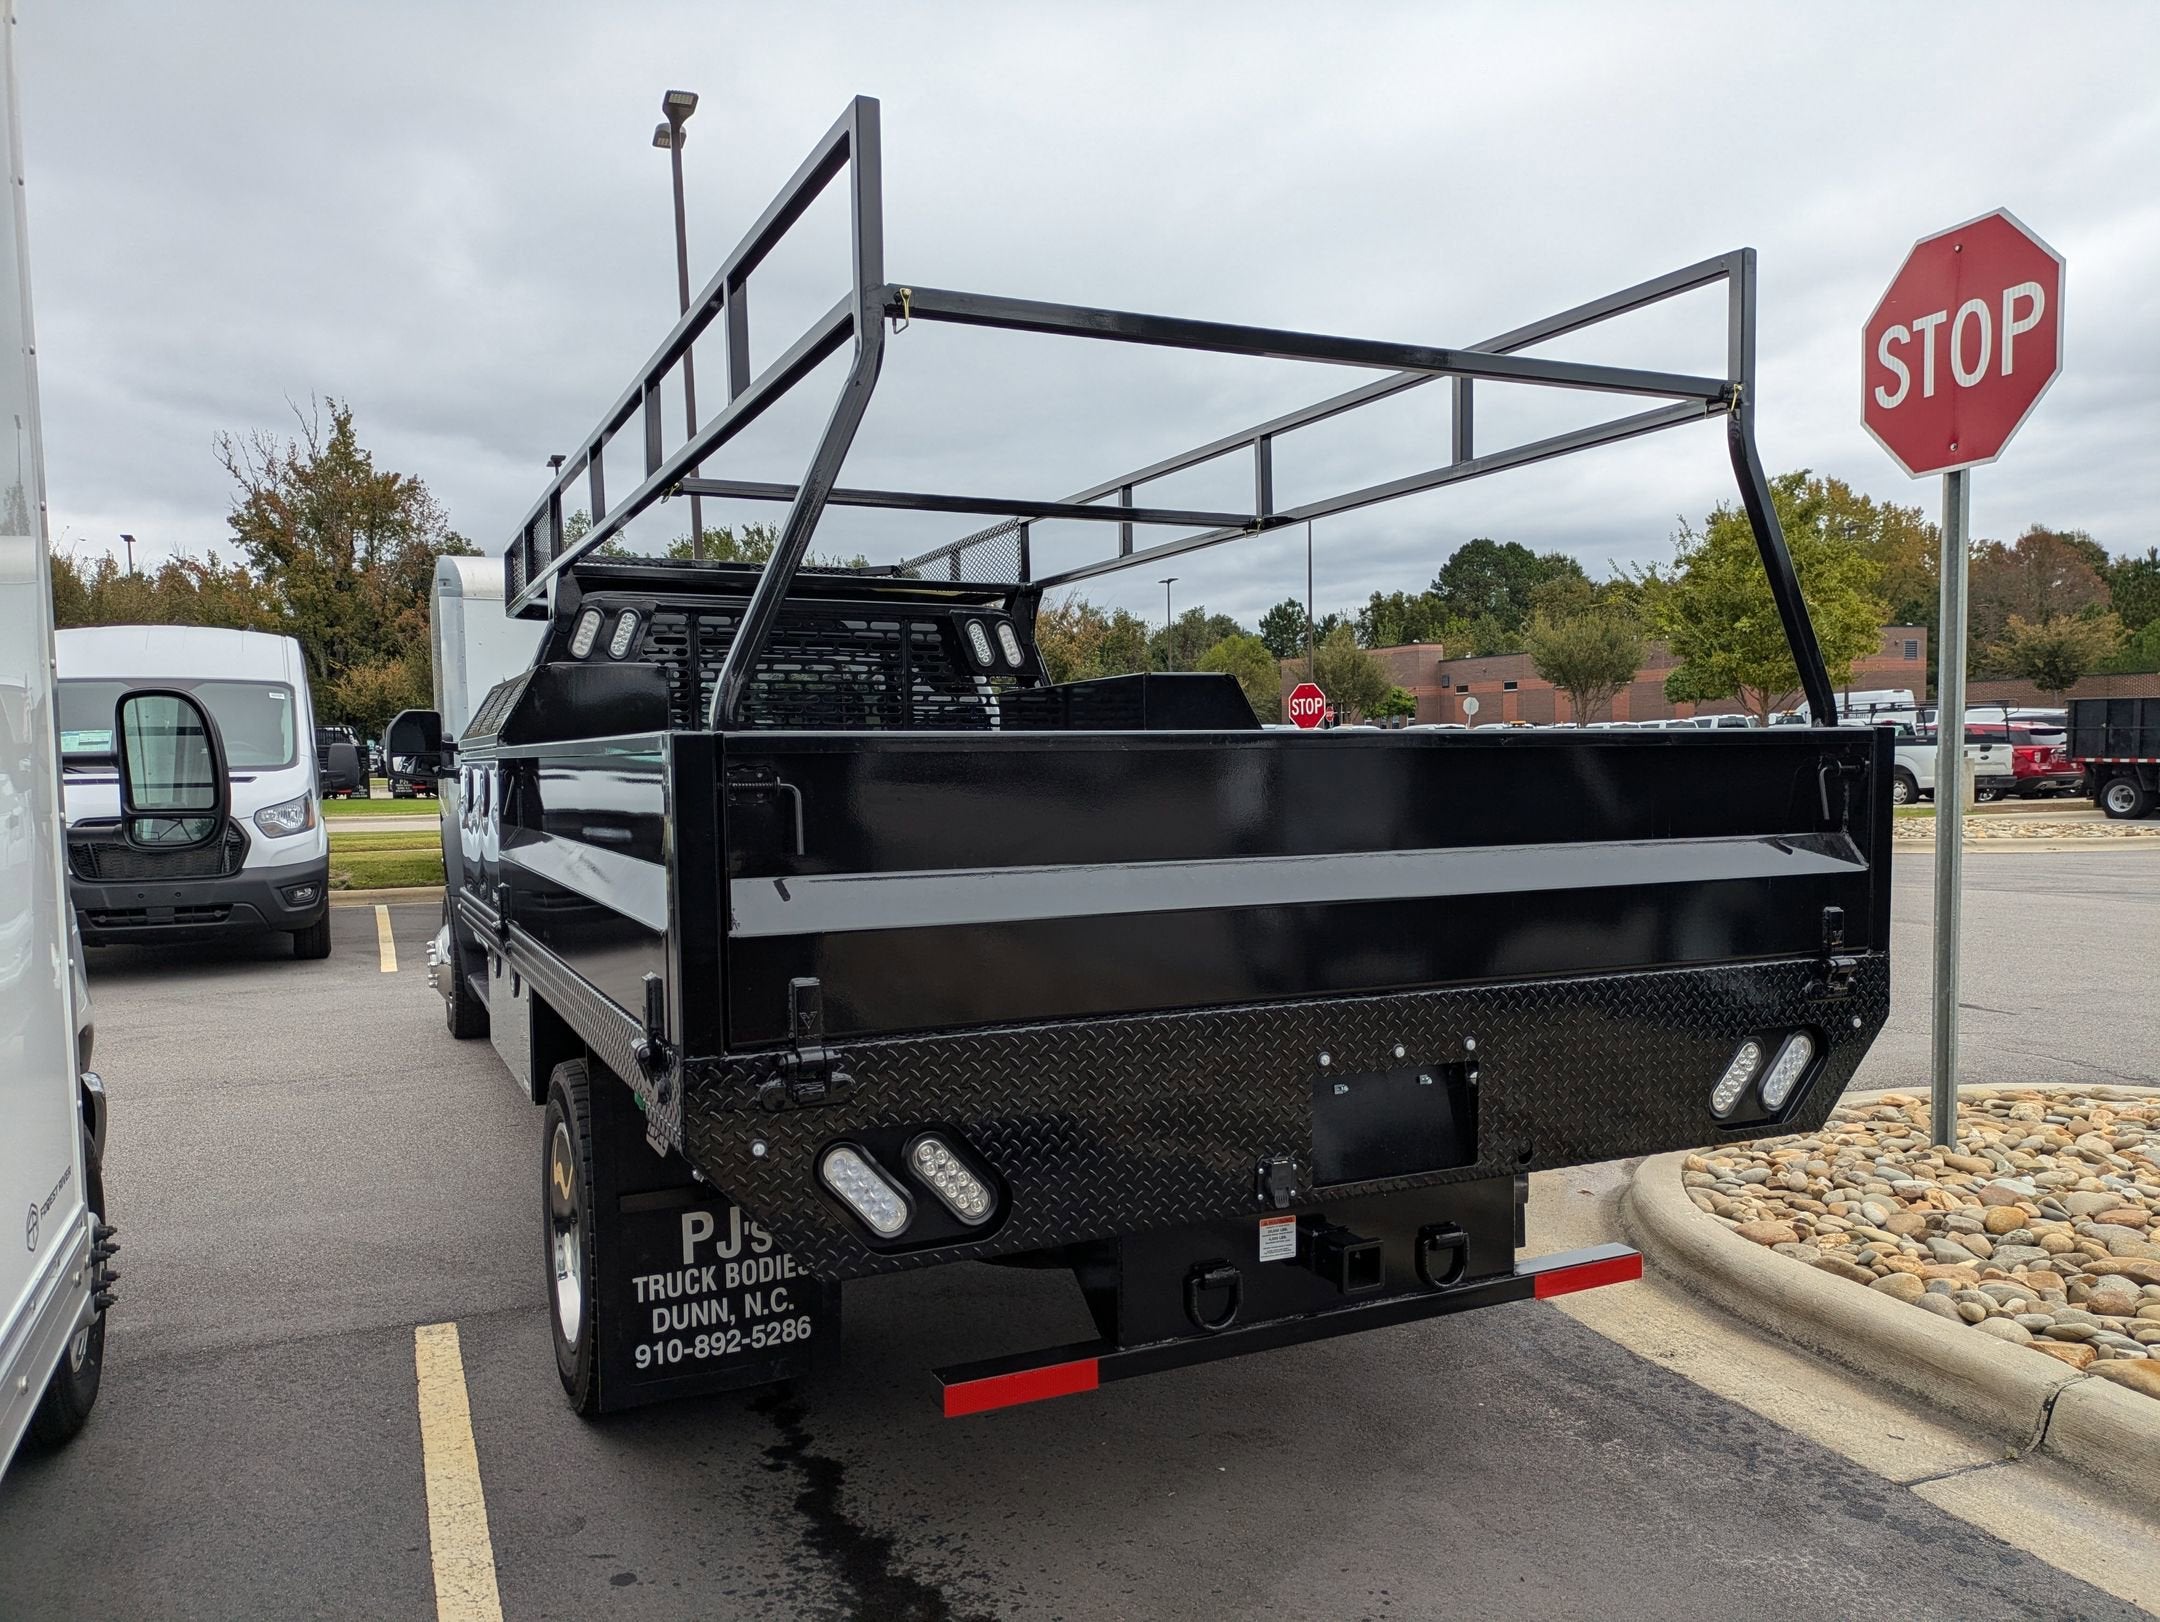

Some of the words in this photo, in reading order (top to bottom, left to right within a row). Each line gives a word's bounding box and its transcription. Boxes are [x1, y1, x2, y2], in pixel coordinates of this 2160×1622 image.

[1874, 281, 2046, 410] STOP
[1291, 697, 1323, 716] STOP
[632, 1265, 717, 1303] TRUCK
[652, 1297, 736, 1334] DUNN,
[744, 1287, 795, 1319] N.C.
[634, 1315, 812, 1369] 910-892-5286
